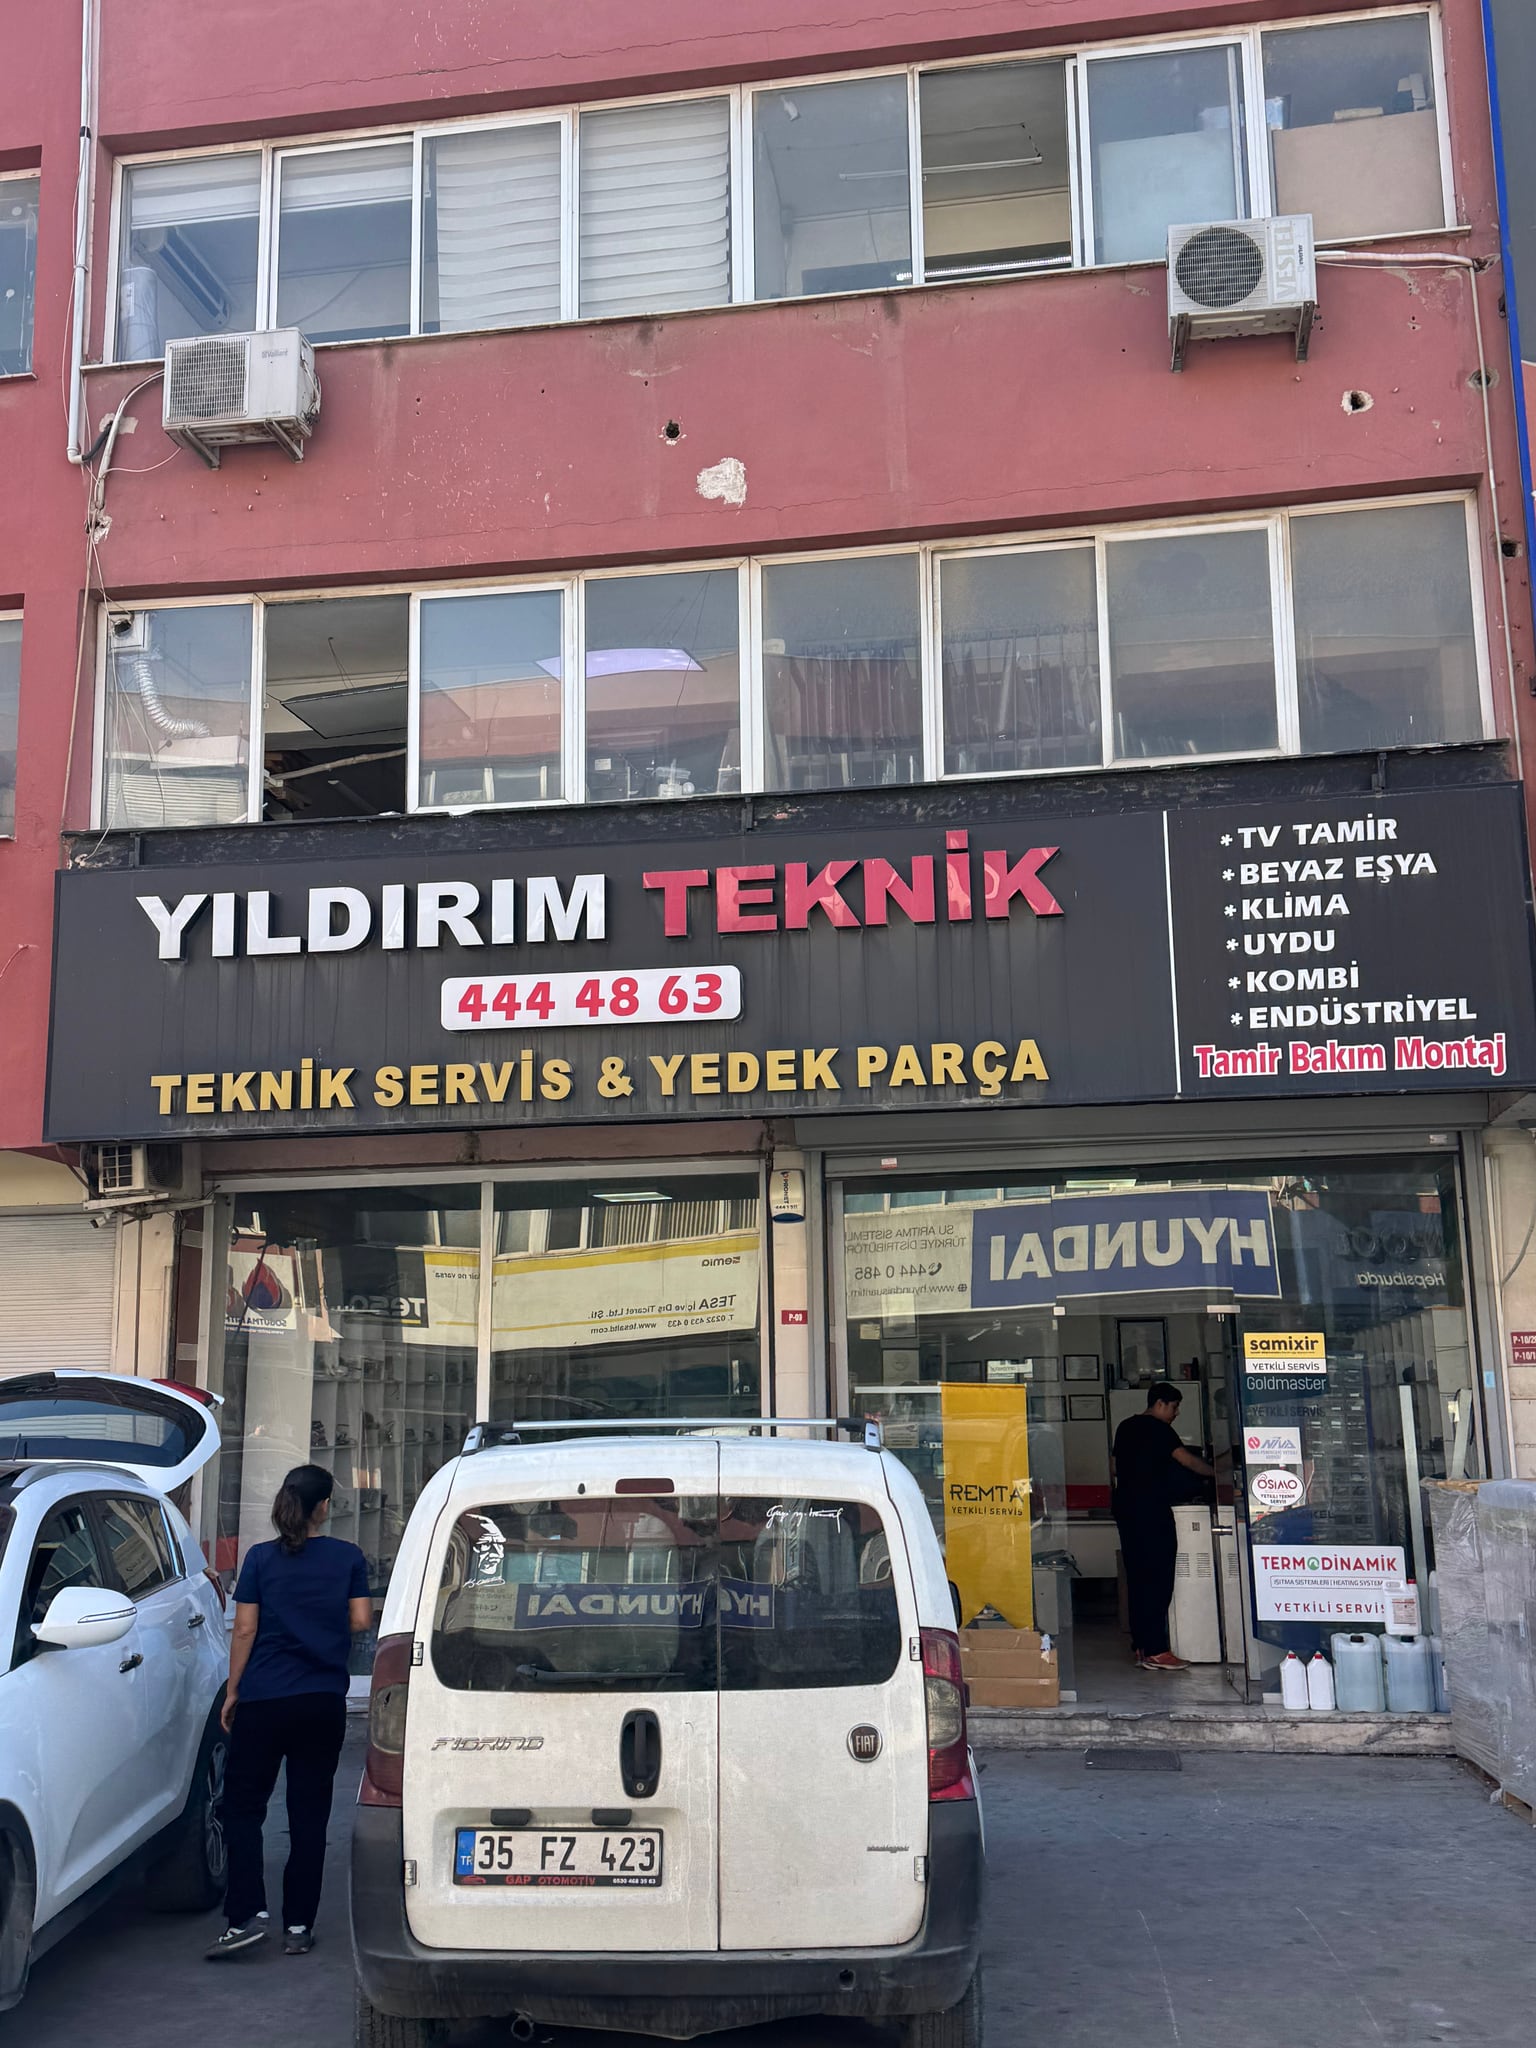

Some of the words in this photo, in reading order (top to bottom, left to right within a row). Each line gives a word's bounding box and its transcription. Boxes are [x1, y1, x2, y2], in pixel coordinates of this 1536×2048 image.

[1274, 220, 1296, 299] VESTEL
[1238, 826, 1282, 849] TV
[1292, 813, 1398, 846] TAMİR
[1240, 858, 1344, 885] BEYAZ
[1355, 852, 1437, 883] EŞYA
[137, 874, 606, 959] YILDIRIM
[643, 829, 1064, 938] TEKNİK
[1242, 891, 1350, 920] KLİMA
[1244, 930, 1335, 956] UYDU
[1246, 960, 1359, 993] KOMBİ
[457, 981, 556, 1022] 444
[574, 976, 639, 1018] 48
[658, 973, 724, 1014] 63
[1249, 994, 1477, 1029] ENDÜSTRİYEL
[1193, 1043, 1282, 1078] Tamir
[1289, 1040, 1386, 1074] Bakım
[1394, 1033, 1507, 1076] Montaj
[151, 1057, 357, 1115] TEKNİK
[373, 1049, 573, 1107] SERVİS
[596, 1057, 634, 1097] &
[649, 1048, 841, 1096] YEDEK
[857, 1039, 1050, 1097] PARÇA
[1249, 1336, 1319, 1351] samixir
[1252, 1360, 1286, 1371] YETKİLİ
[1287, 1361, 1320, 1371] SERVİS
[1246, 1376, 1327, 1390] Goldmaster
[950, 1484, 1024, 1503] REMTA
[951, 1506, 987, 1515] YETKİLİ
[989, 1507, 1023, 1516] SERVİS
[1260, 1554, 1398, 1571] TERMODİNAMİK
[1274, 1601, 1331, 1613] YETKİLİ
[431, 1736, 544, 1752] FIORINO
[855, 1735, 875, 1752] FIAT
[460, 1855, 473, 1866] TR
[478, 1836, 514, 1870] 35
[540, 1836, 577, 1871] FZ
[600, 1836, 656, 1872] 423
[506, 1875, 531, 1885] GAP
